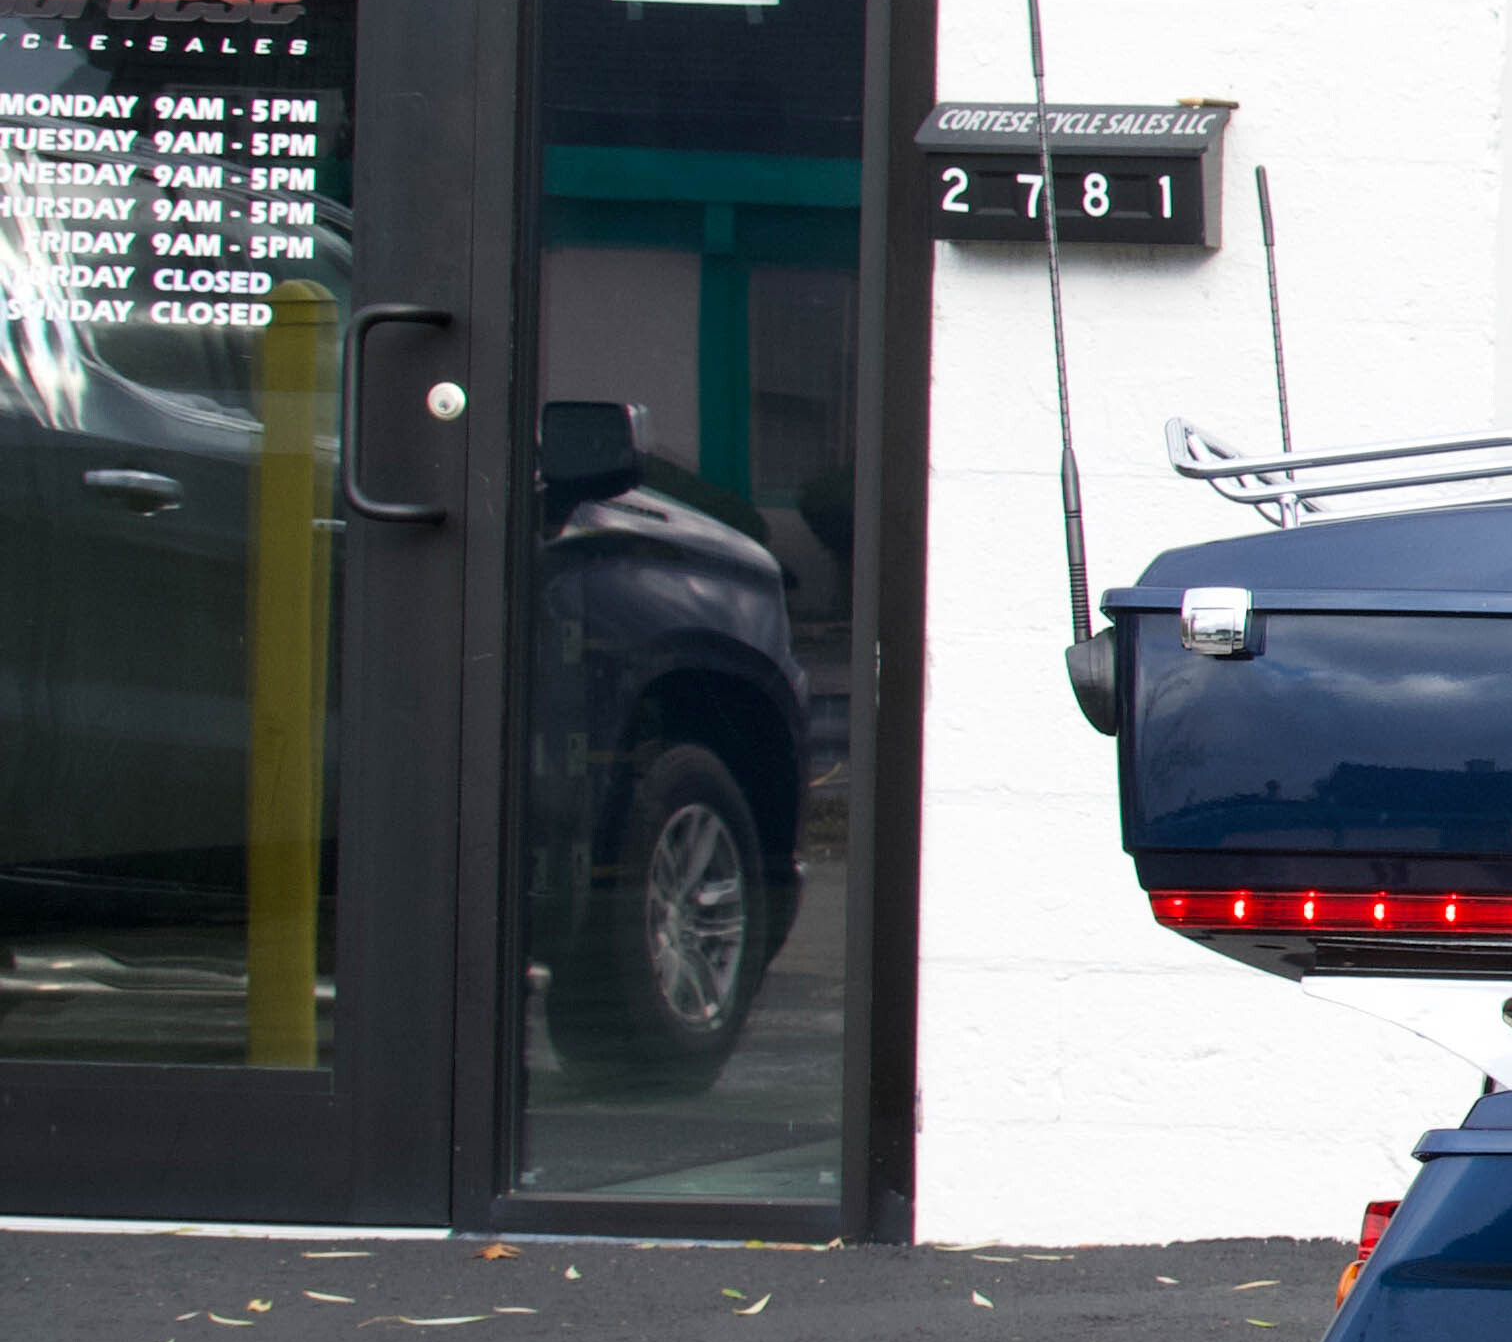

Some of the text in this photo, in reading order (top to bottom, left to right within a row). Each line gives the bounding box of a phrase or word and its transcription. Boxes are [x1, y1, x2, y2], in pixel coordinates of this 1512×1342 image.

[148, 35, 309, 56] SALES
[0, 93, 139, 118] MONDAY
[154, 96, 225, 120] 9AM
[250, 99, 317, 123] 5PM
[938, 109, 1038, 133] CORTESE
[1102, 113, 1173, 135] SALES
[1172, 114, 1218, 136] LLC
[0, 126, 138, 152] TUESDAY
[153, 130, 224, 155] 9AM
[250, 132, 317, 157] 5PM
[152, 164, 223, 189] 9AM
[250, 167, 316, 191] 5PM
[152, 198, 222, 223] 9AM
[250, 201, 315, 225] 5PM
[24, 230, 136, 254] FRIDAY
[151, 232, 222, 257] 9AM
[249, 236, 314, 259] 5PM
[153, 268, 273, 294] CLOSED
[151, 301, 273, 326] CLOSED
